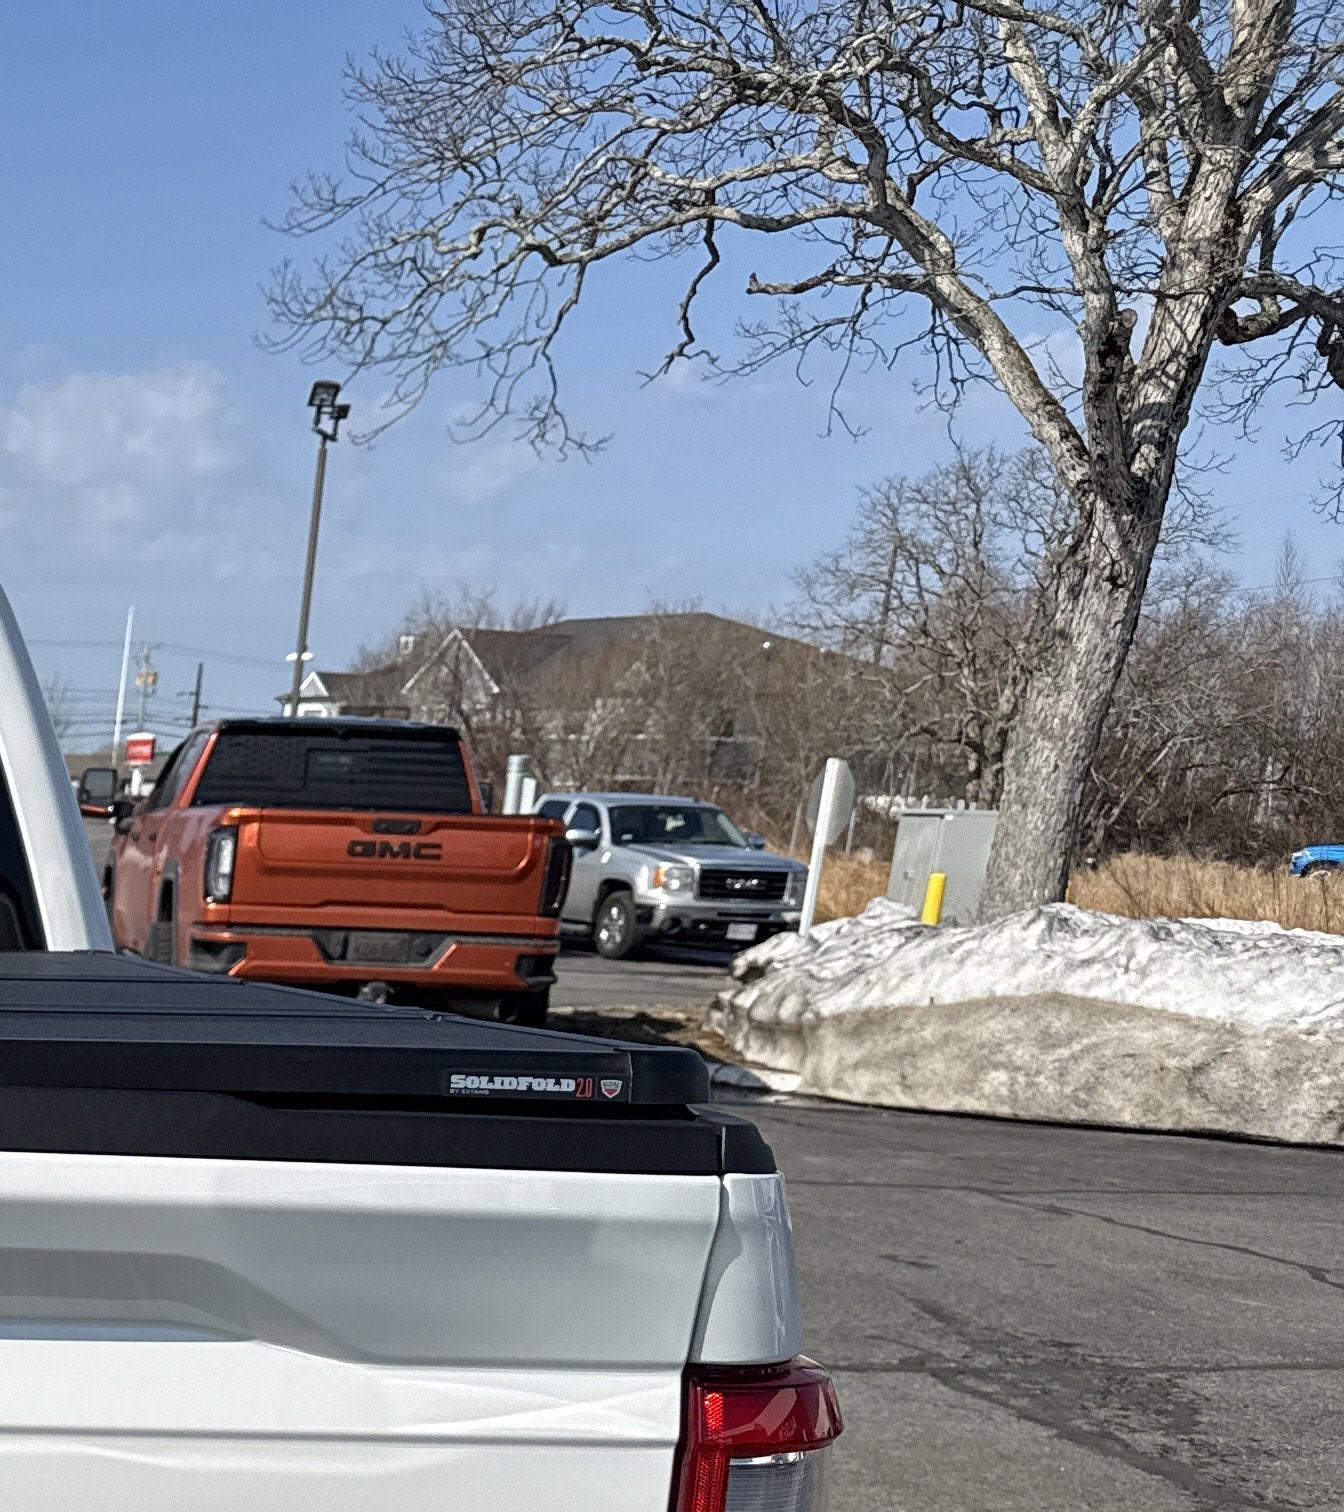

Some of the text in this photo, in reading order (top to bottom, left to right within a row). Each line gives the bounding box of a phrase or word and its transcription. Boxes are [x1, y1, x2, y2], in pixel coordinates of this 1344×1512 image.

[347, 840, 442, 860] GMC
[450, 1074, 576, 1092] SOLIDFOLD
[576, 1077, 593, 1098] 2.0
